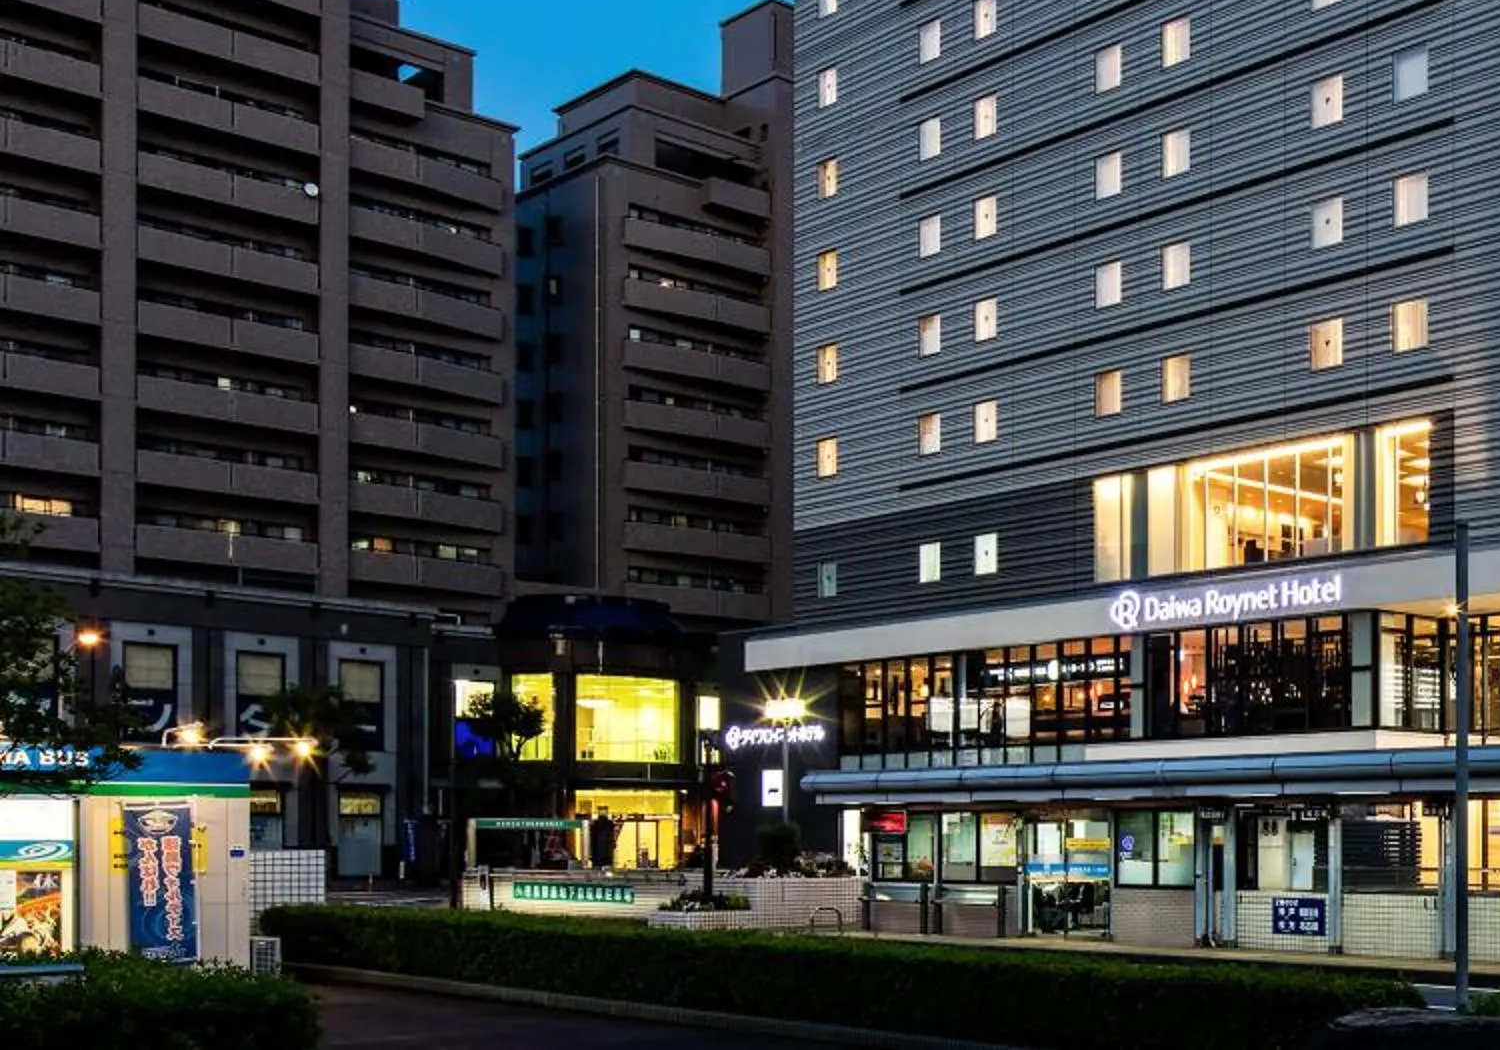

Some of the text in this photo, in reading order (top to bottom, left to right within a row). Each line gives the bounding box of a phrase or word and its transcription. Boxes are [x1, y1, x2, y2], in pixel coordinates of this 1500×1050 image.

[1144, 593, 1202, 622] Daiwa
[1205, 583, 1279, 619] Roynet
[1280, 573, 1343, 608] Hotel
[39, 749, 90, 767] BUS
